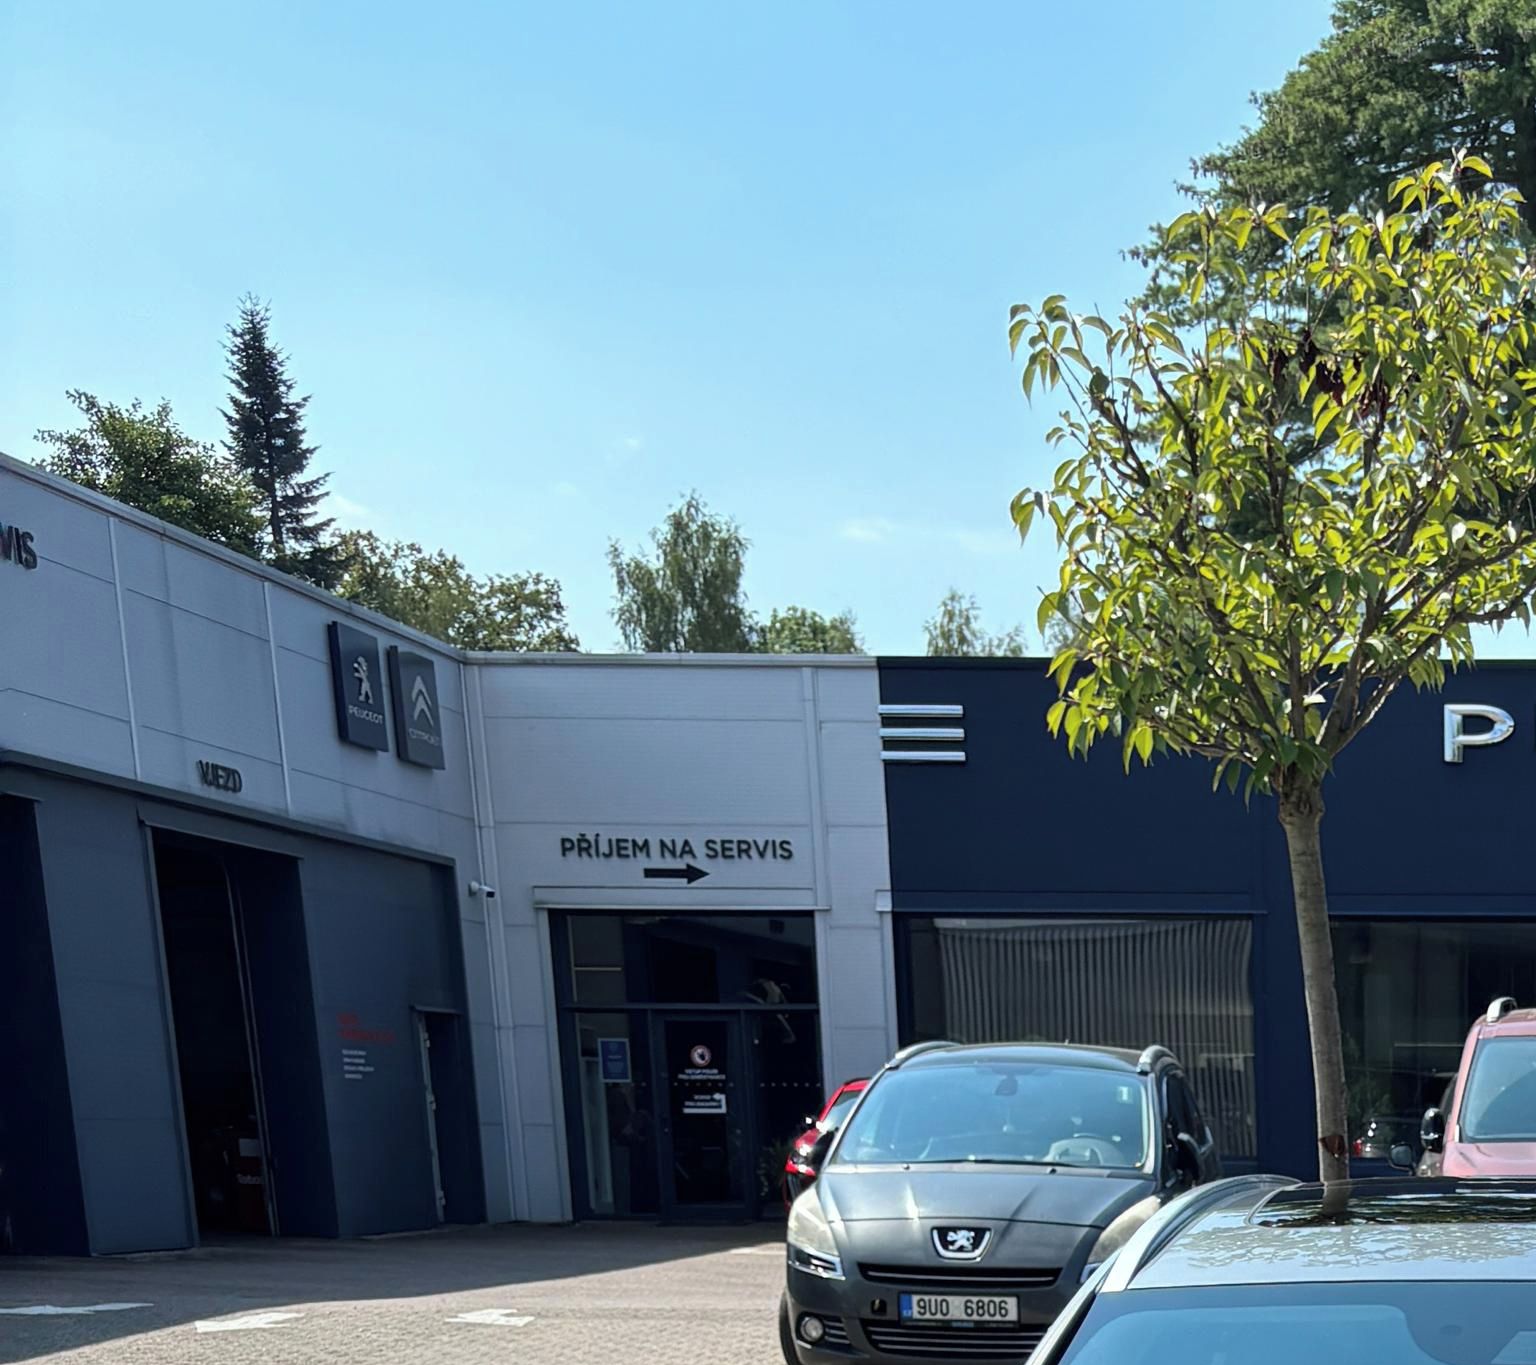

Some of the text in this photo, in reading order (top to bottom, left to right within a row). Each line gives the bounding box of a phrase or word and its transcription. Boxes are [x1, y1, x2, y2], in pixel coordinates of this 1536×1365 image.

[348, 704, 384, 725] PEUGEOT
[560, 834, 793, 860] PŘÍJEM NA SERVIS
[917, 1298, 1009, 1318] 9U0 6806
